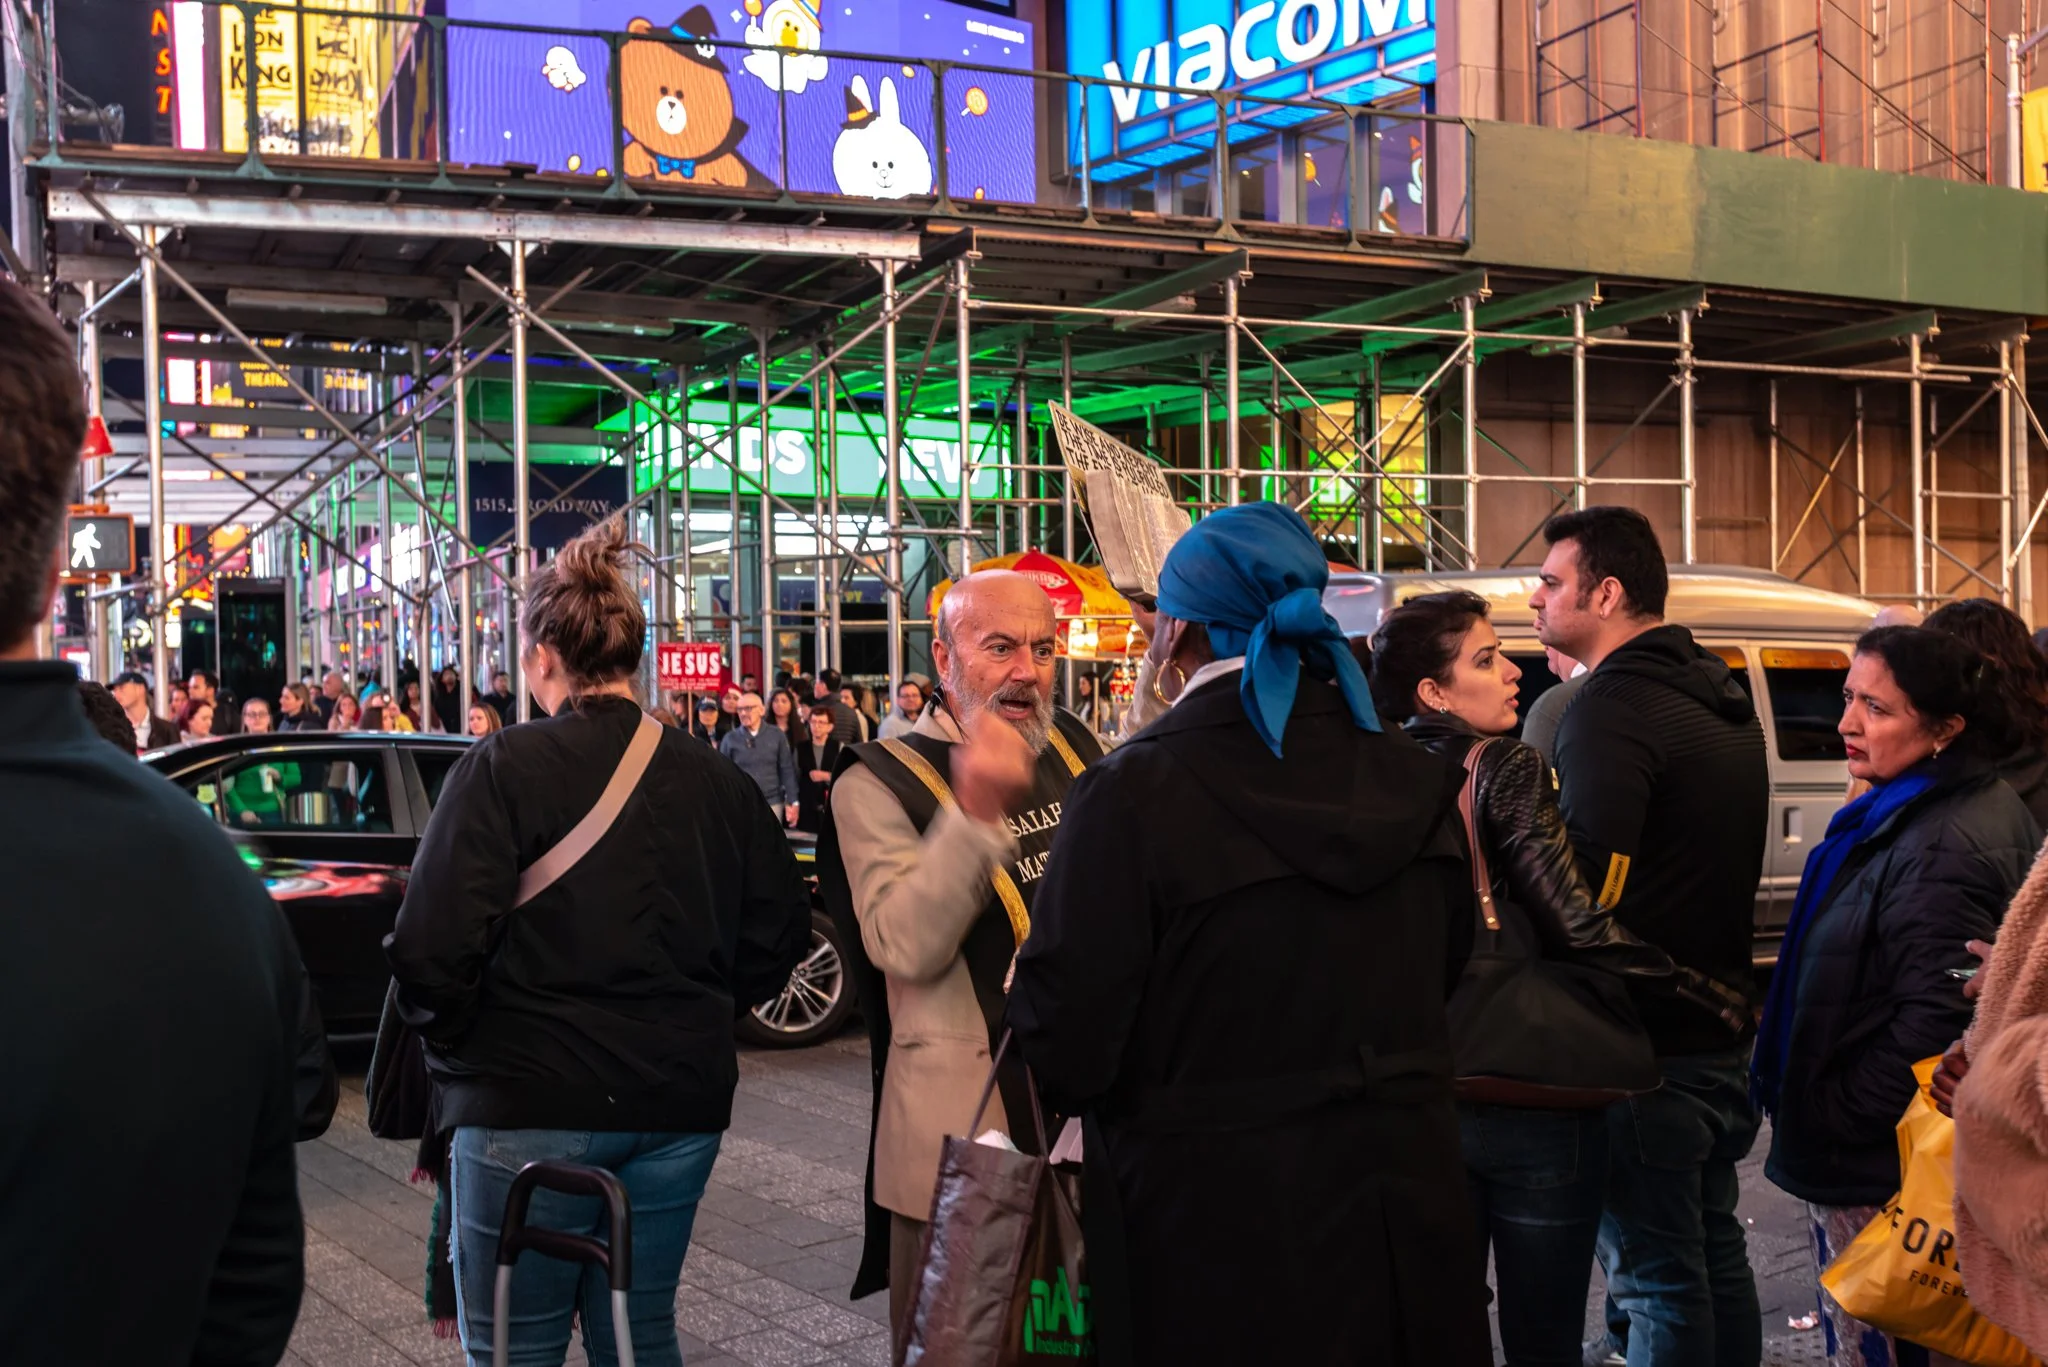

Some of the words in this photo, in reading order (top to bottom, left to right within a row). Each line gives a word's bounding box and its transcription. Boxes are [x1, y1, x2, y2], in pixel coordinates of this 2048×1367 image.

[233, 24, 283, 52] LON
[230, 56, 291, 89] KNG
[1061, 427, 1086, 453] THE
[1083, 439, 1112, 467] TIME
[1069, 418, 1099, 447] WISE
[1099, 435, 1121, 459] AND
[1120, 447, 1160, 480] REPENT
[475, 498, 507, 512] 1515
[514, 499, 610, 513] ROADWAY
[661, 651, 720, 676] JESUS
